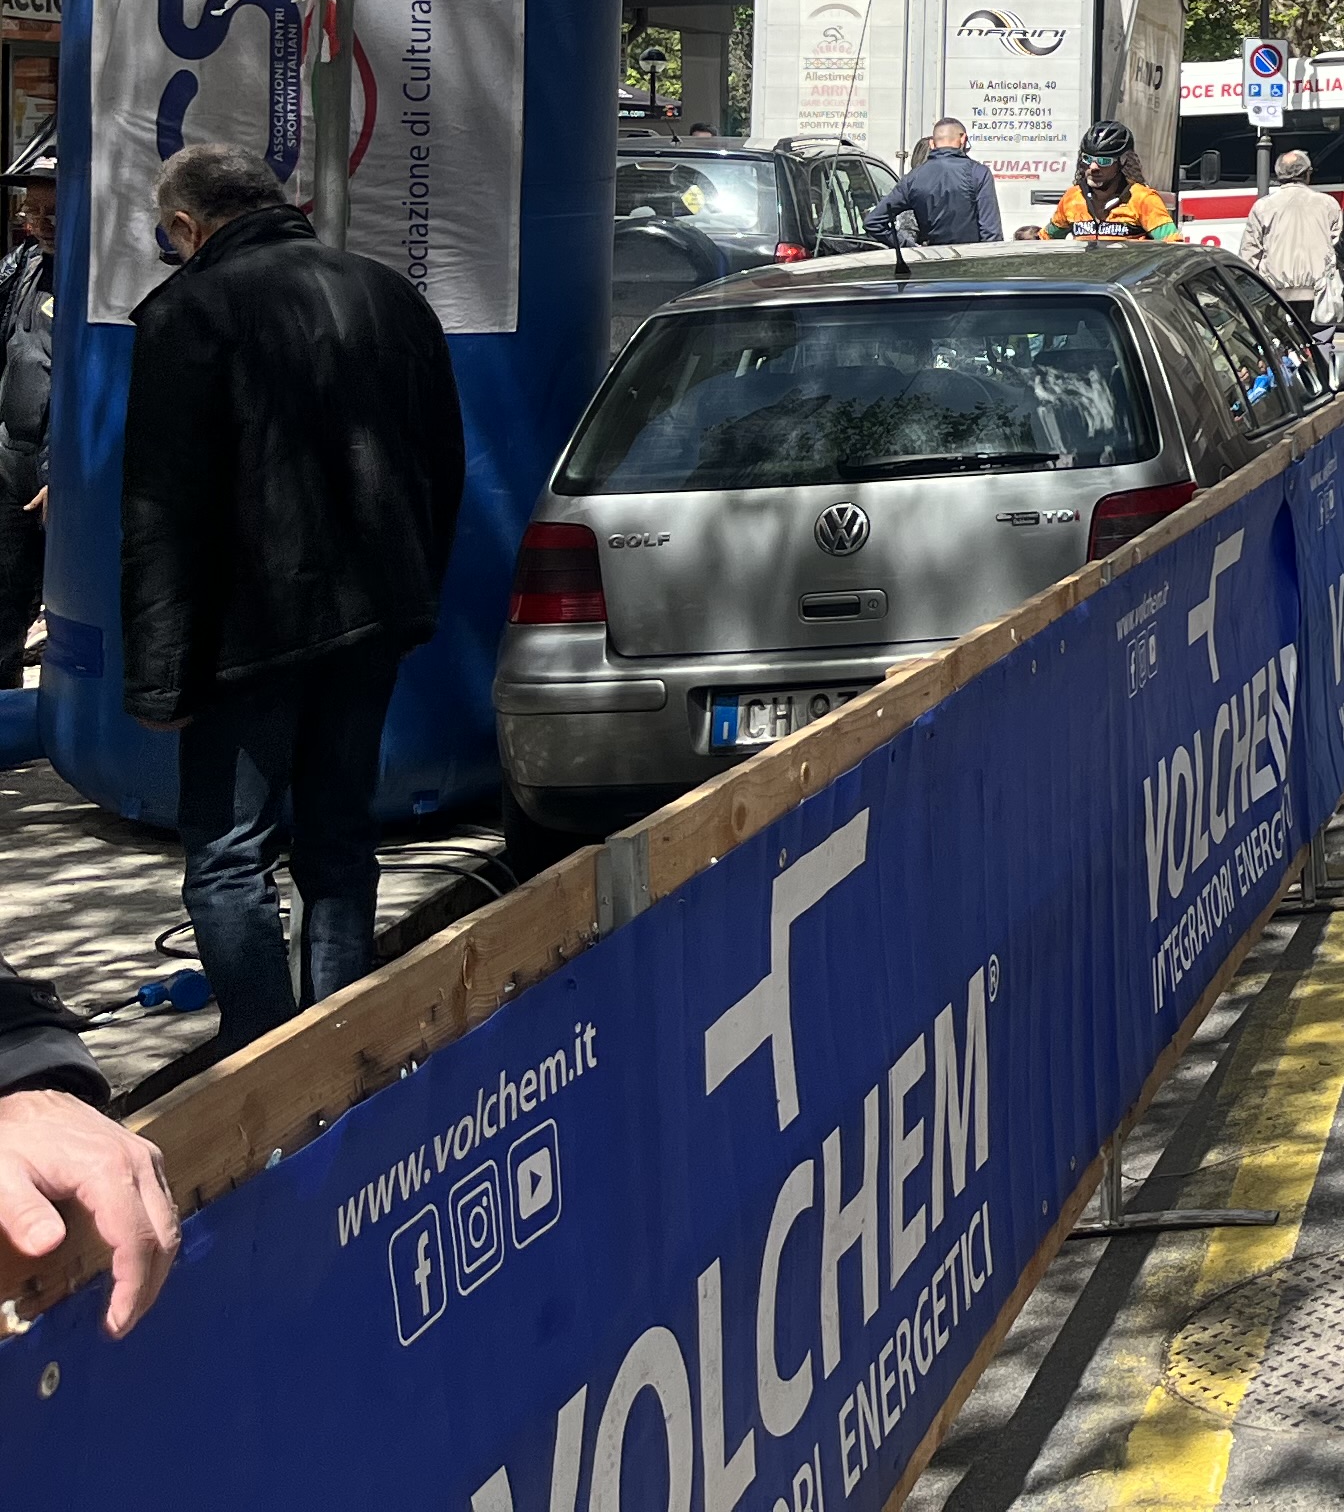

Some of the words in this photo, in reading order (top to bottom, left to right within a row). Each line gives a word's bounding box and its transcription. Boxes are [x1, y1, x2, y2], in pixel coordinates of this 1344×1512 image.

[274, 7, 286, 59] CENTRI
[287, 23, 299, 83] ITALIANI
[804, 71, 865, 81] Allestimenti
[969, 80, 984, 89] Via
[987, 80, 1042, 90] Anticolana,
[1044, 80, 1057, 89] 40
[1180, 84, 1214, 99] OCE
[274, 62, 285, 163] ASSOCIAZIONE
[286, 85, 298, 148] SPORTIVI
[972, 107, 988, 116] Tel.
[984, 94, 1018, 105] Anagni
[1021, 94, 1042, 105] (FR)
[402, 110, 430, 138] di
[981, 160, 1067, 173] EUMATICI
[402, 144, 430, 295] sociazione
[607, 531, 671, 549] GOLF
[1152, 861, 1235, 1015] INTEGRATORI
[337, 1021, 597, 1247] www.volchem.it
[838, 1200, 994, 1498] ENERGETICI
